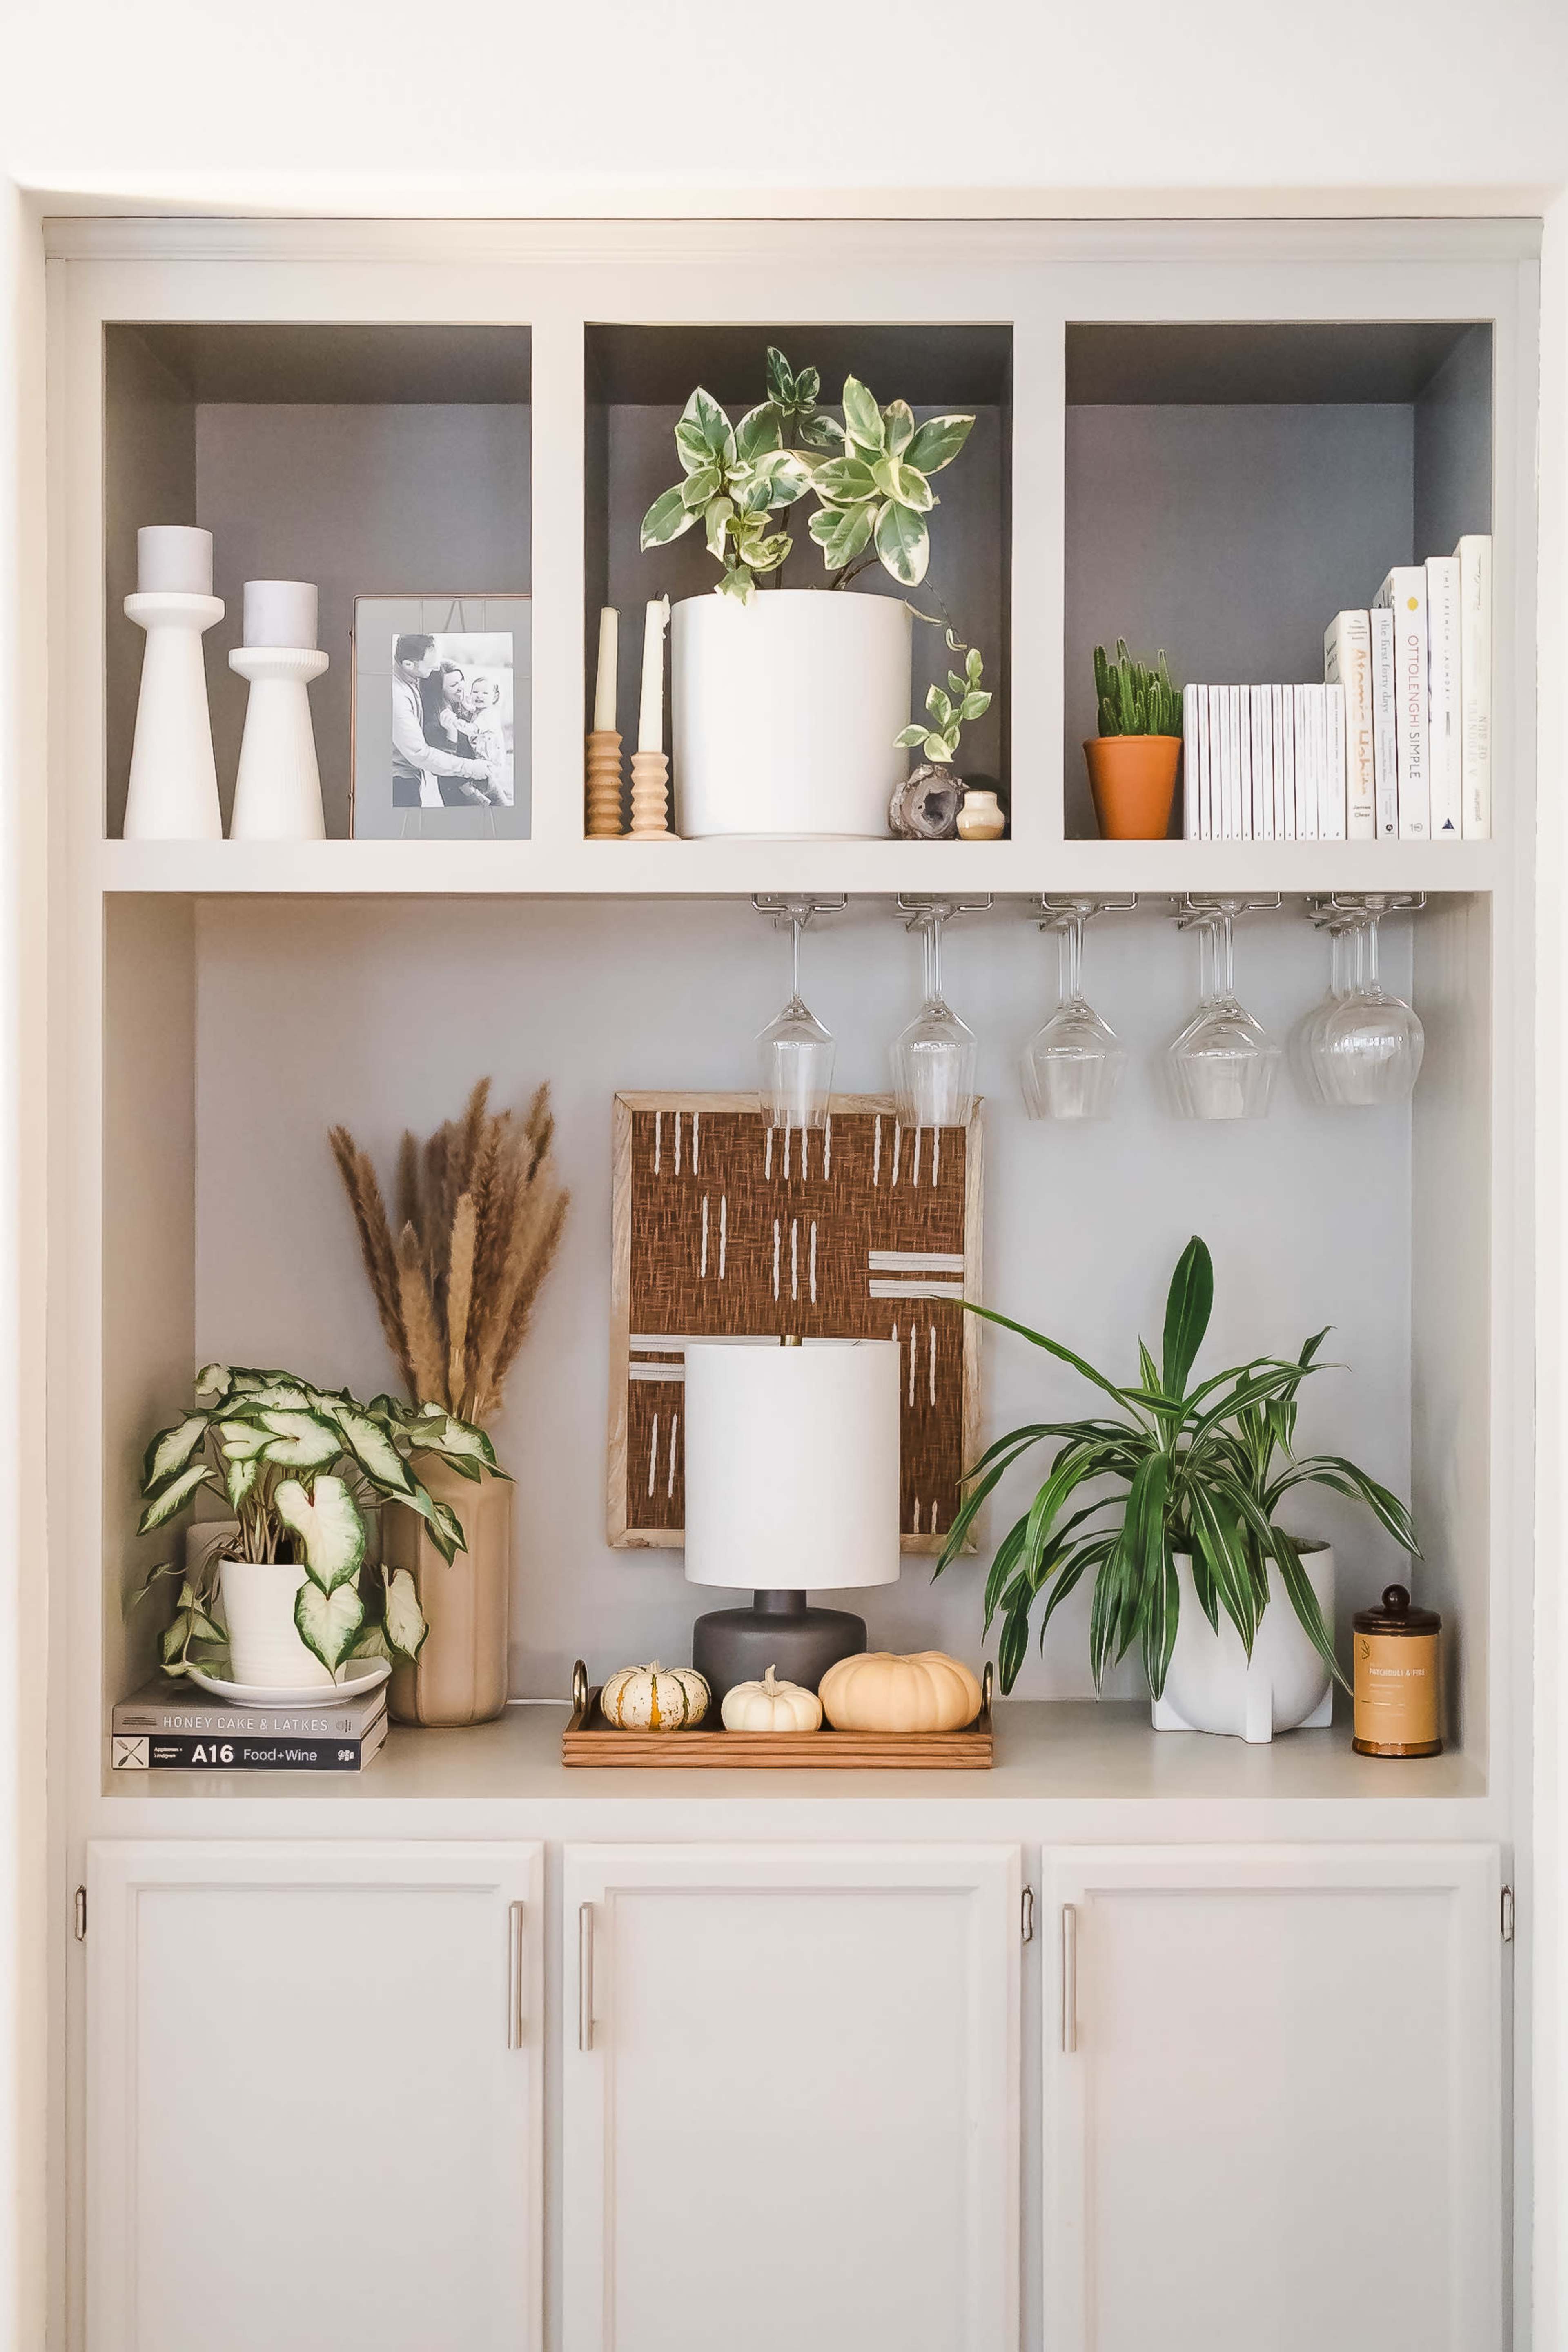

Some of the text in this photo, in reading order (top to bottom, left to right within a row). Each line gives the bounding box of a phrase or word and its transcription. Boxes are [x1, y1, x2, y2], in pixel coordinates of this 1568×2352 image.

[1378, 620, 1393, 713] the first forty days
[1407, 635, 1421, 779] OTTOLENGHI SIMPLE
[163, 1716, 212, 1728] HONEY
[217, 1717, 254, 1730] CAKE
[260, 1719, 268, 1730] &
[274, 1719, 328, 1731] LATKES
[191, 1744, 234, 1763] A16
